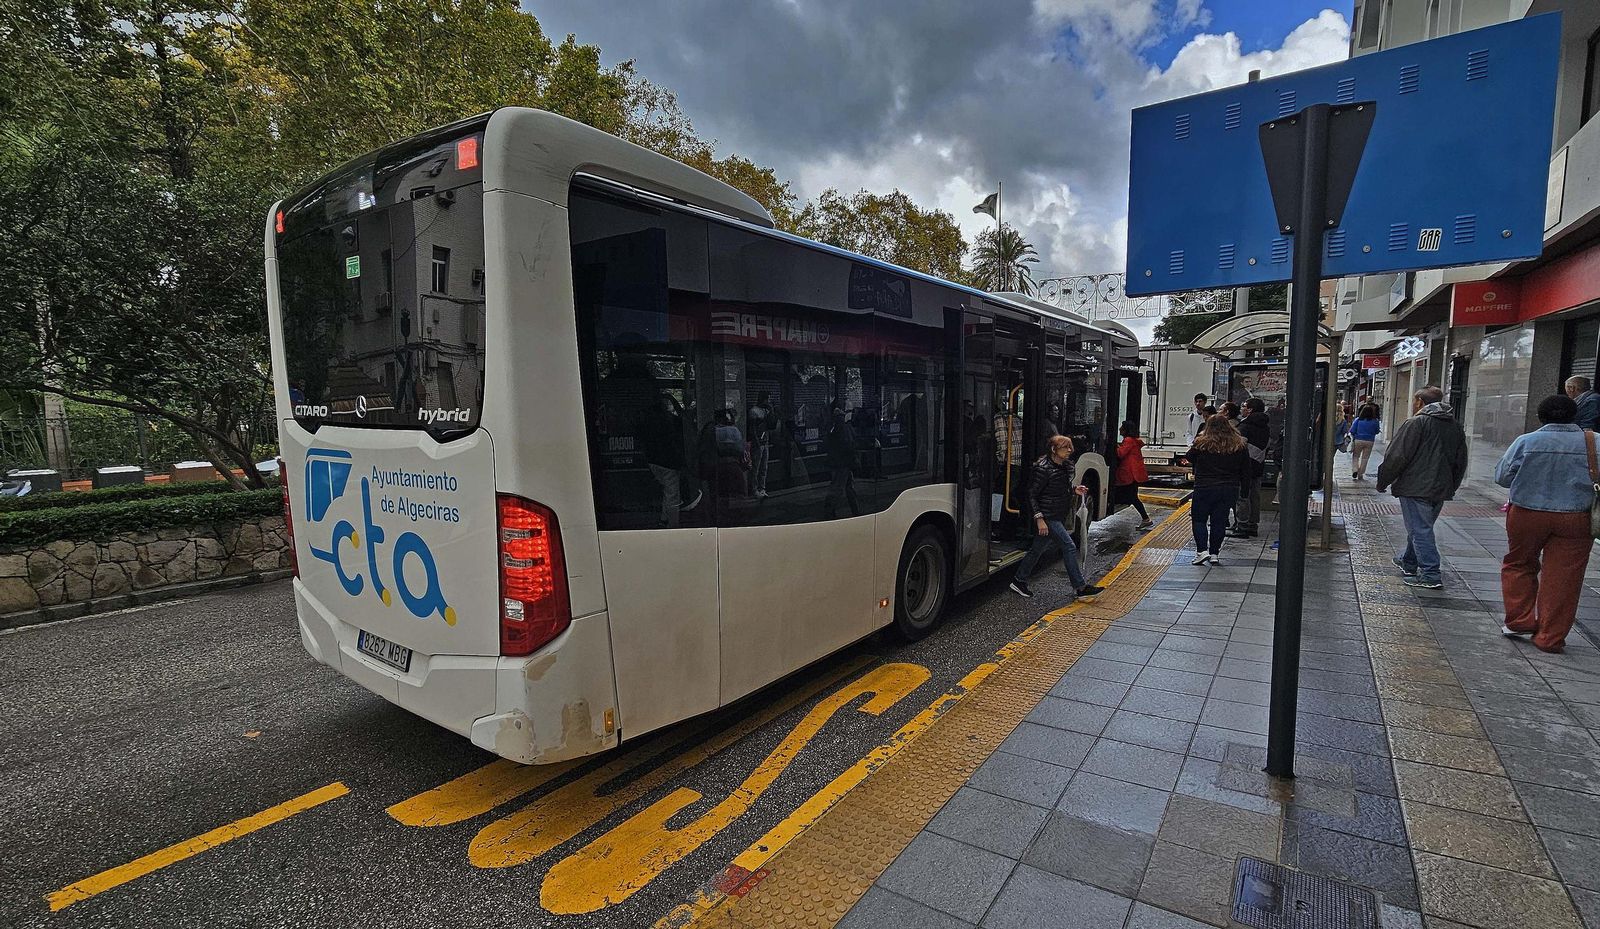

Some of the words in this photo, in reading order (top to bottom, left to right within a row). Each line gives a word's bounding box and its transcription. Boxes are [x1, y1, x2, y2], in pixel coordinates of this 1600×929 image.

[1465, 303, 1513, 313] MAPFRE
[294, 404, 328, 417] CITARO
[418, 406, 471, 425] hybrid
[371, 465, 458, 491] Ayuntamiento
[380, 498, 395, 514] de
[398, 498, 460, 523] Algeciras
[364, 633, 386, 657] 8262
[387, 643, 408, 665] MBG
